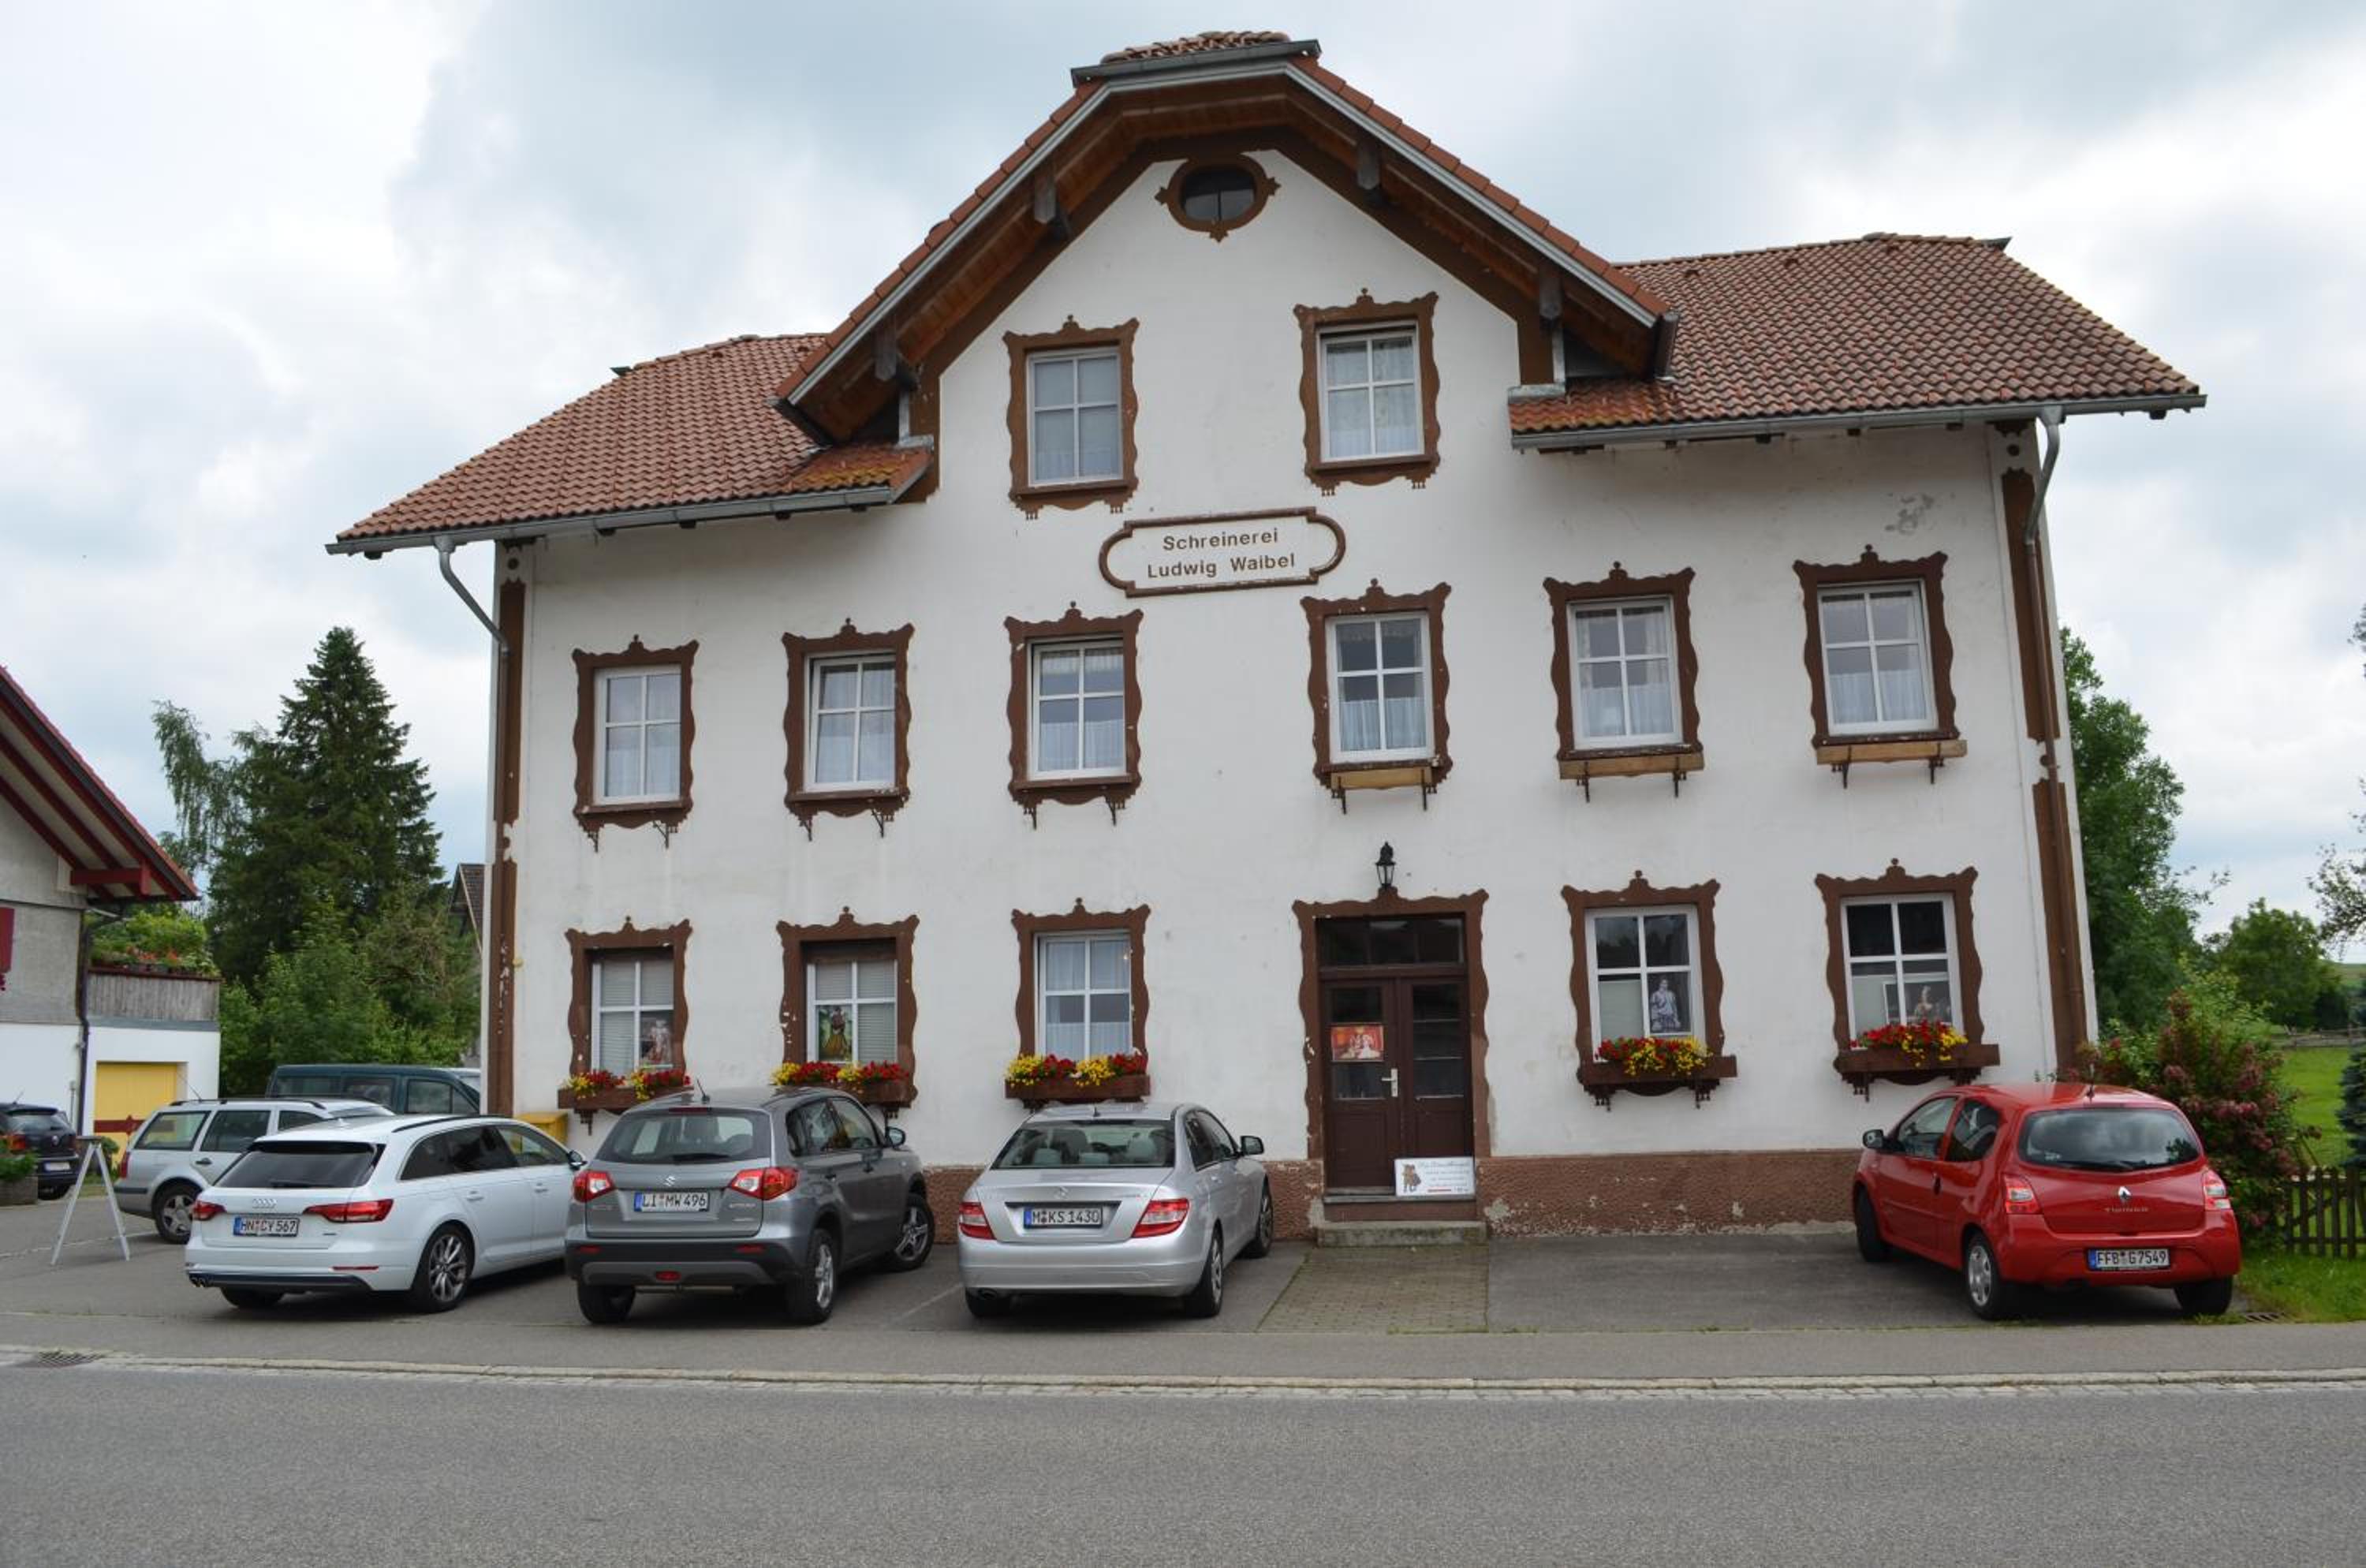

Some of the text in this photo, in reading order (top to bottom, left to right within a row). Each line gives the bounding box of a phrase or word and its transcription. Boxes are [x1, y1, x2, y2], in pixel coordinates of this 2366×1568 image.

[1162, 527, 1278, 551] Schreinerei
[1147, 553, 1295, 578] Ludwig Waibel
